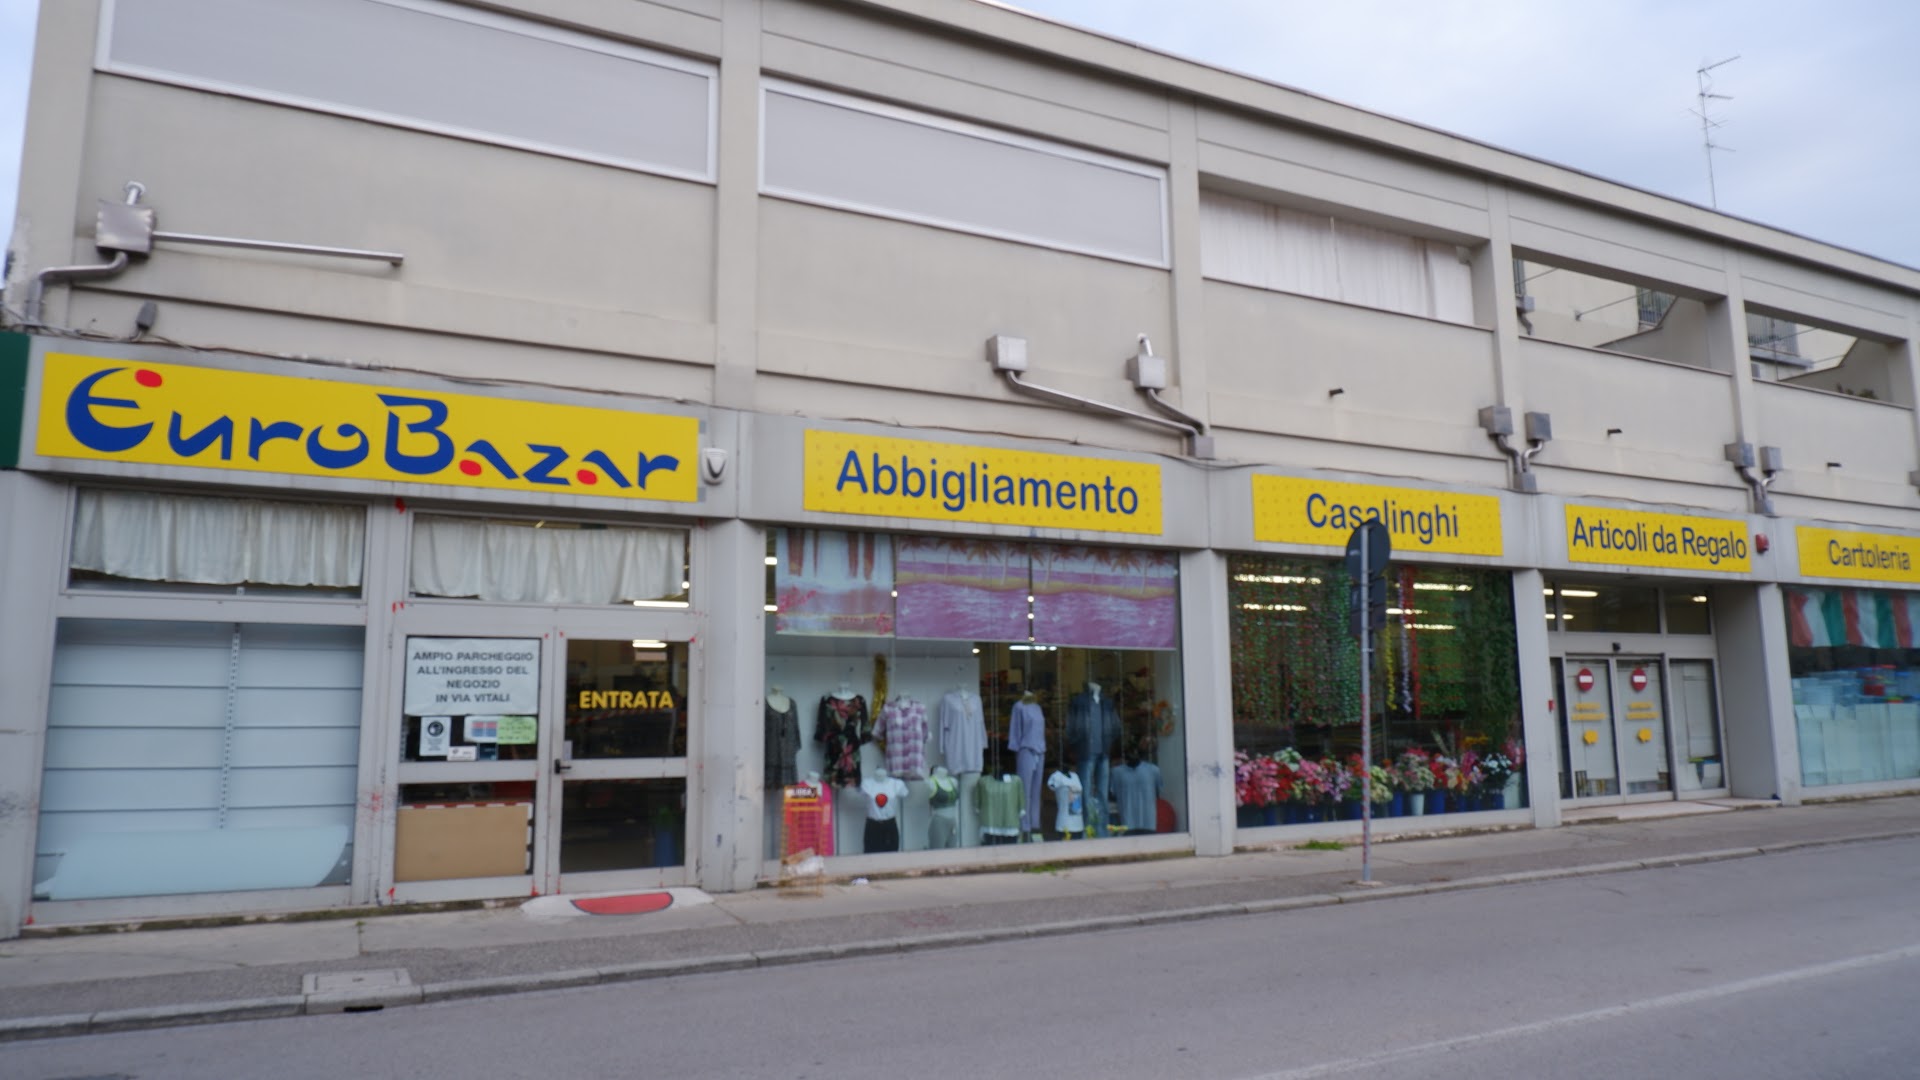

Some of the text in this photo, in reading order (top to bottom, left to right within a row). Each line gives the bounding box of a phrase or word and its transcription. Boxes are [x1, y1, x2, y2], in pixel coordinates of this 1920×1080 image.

[836, 449, 1139, 515] Abbigliamento
[1306, 492, 1459, 545] Casalinghi
[1572, 516, 1748, 565] Articoli da Regalo
[1828, 539, 1912, 571] Cartoleria
[413, 651, 534, 662] AMPIO PARCHEGGIO
[416, 665, 529, 675] ALL'INGRESSO DEL
[446, 679, 501, 689] NEGOZIO
[435, 693, 511, 703] IN VIA VITALI
[579, 690, 674, 709] ENTRATA
